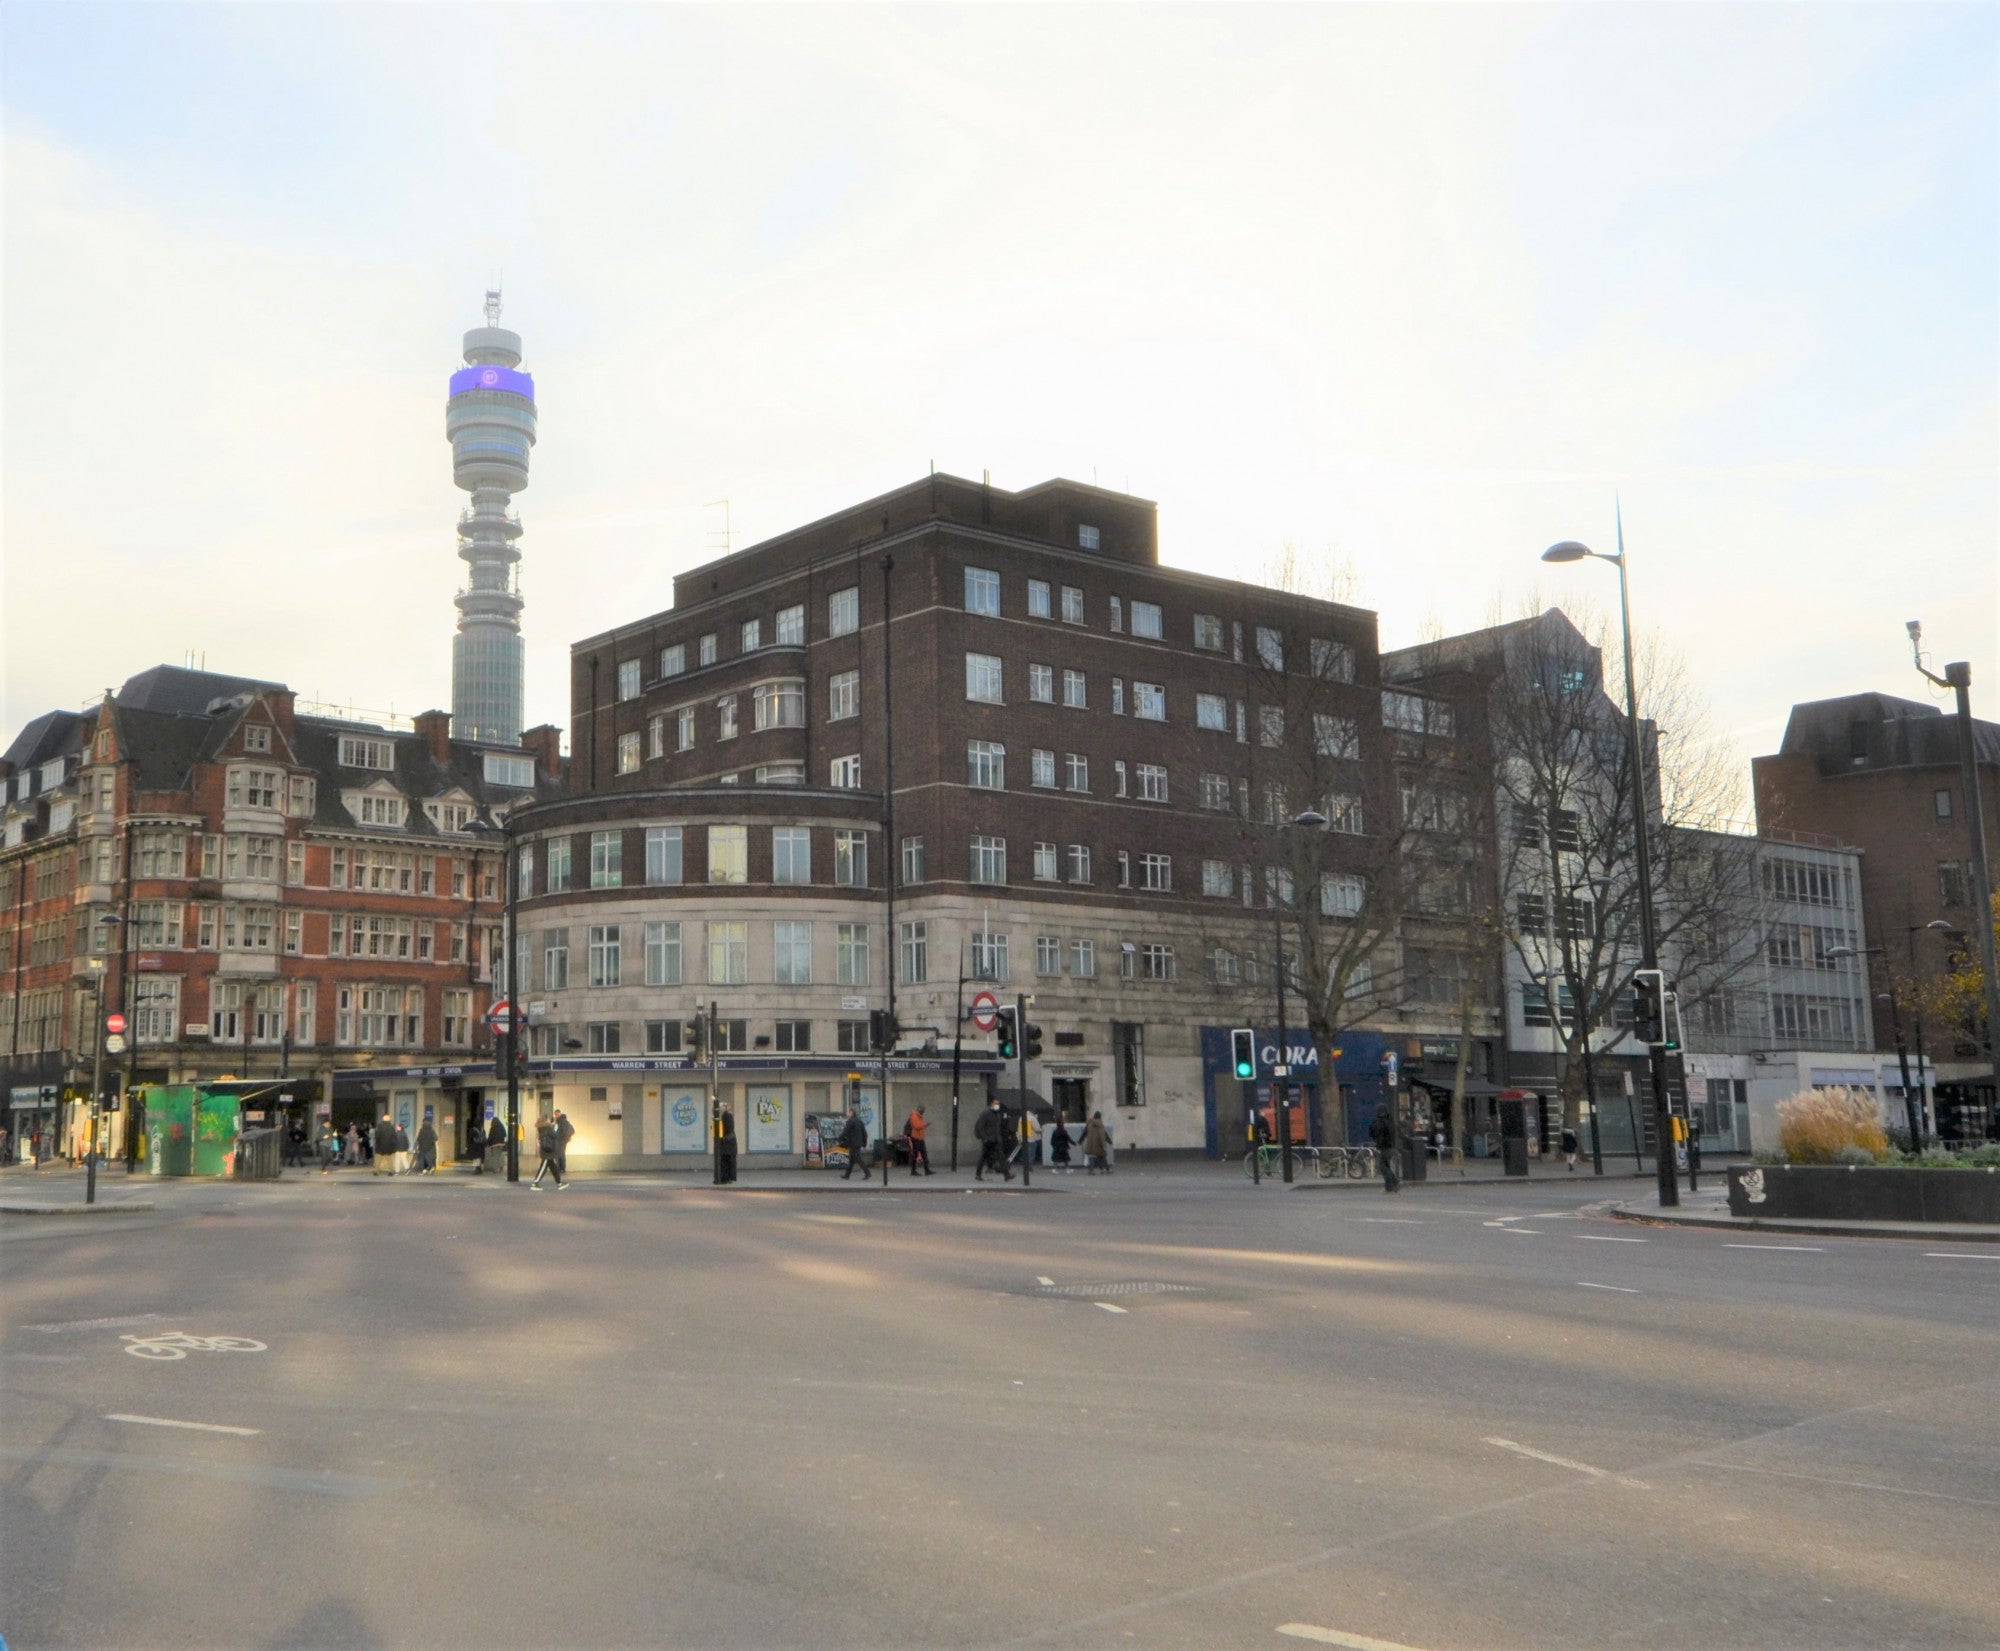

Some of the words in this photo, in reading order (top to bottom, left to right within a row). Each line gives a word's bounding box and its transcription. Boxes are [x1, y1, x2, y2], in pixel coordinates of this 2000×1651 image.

[1261, 1045, 1319, 1065] CORA
[612, 1061, 646, 1069] WARREN
[654, 1061, 682, 1069] STREET
[855, 1061, 882, 1069] WARREN
[888, 1061, 909, 1069] STREET
[915, 1061, 940, 1069] STATION
